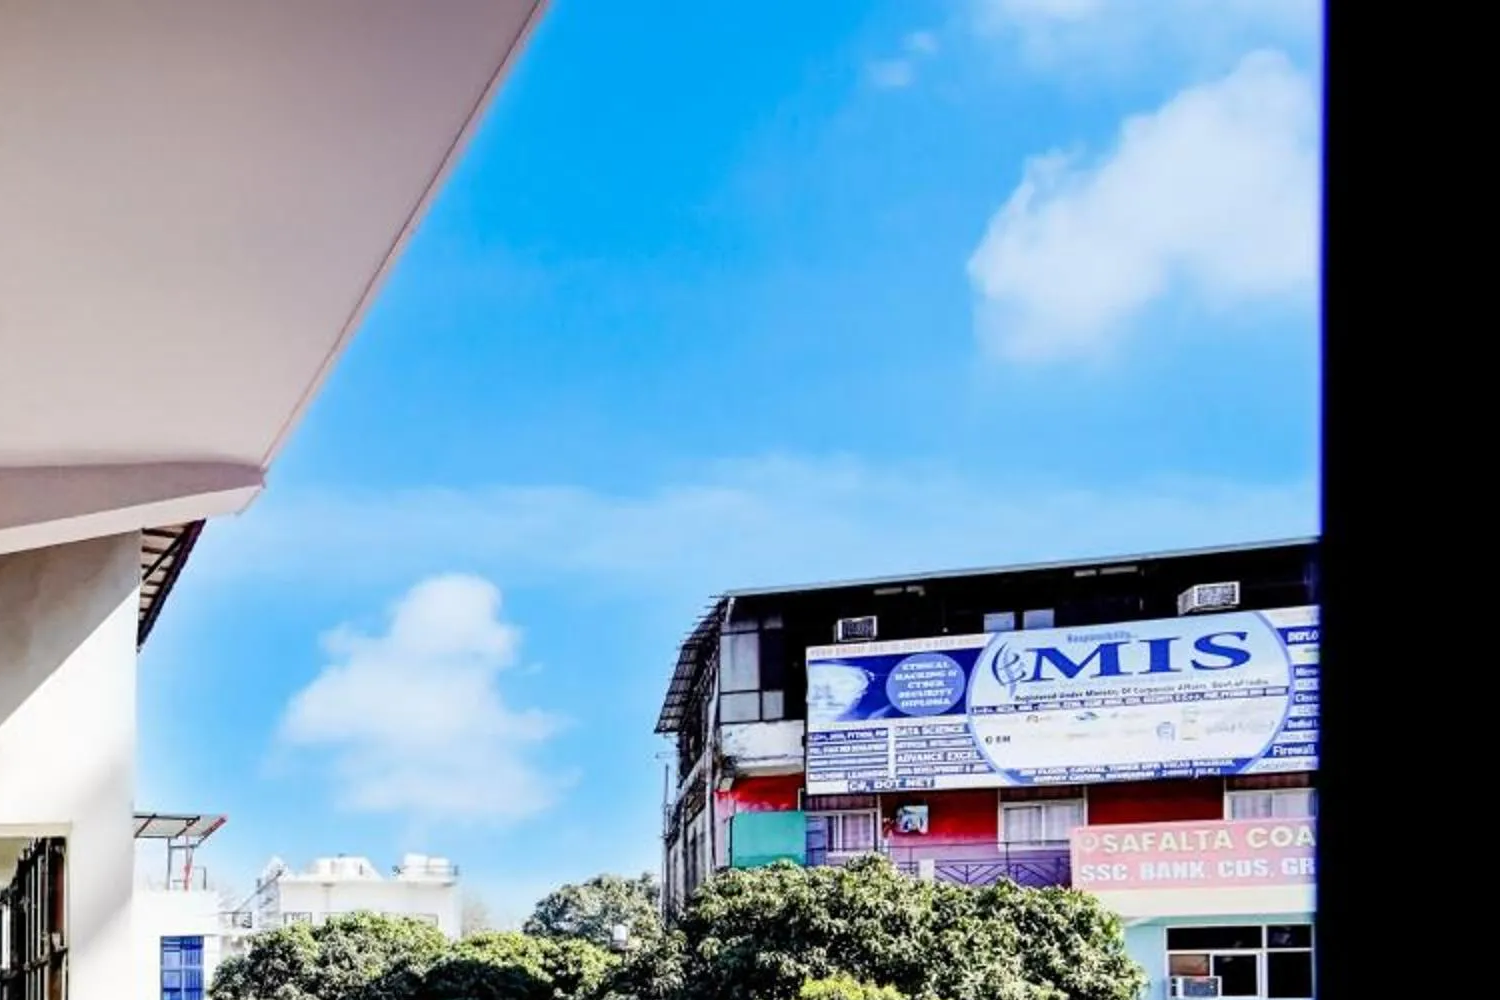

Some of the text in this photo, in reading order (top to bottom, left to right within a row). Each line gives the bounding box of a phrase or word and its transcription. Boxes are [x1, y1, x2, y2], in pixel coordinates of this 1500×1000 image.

[1021, 631, 1252, 683] MIS
[1103, 825, 1316, 854] SAFALTA COA
